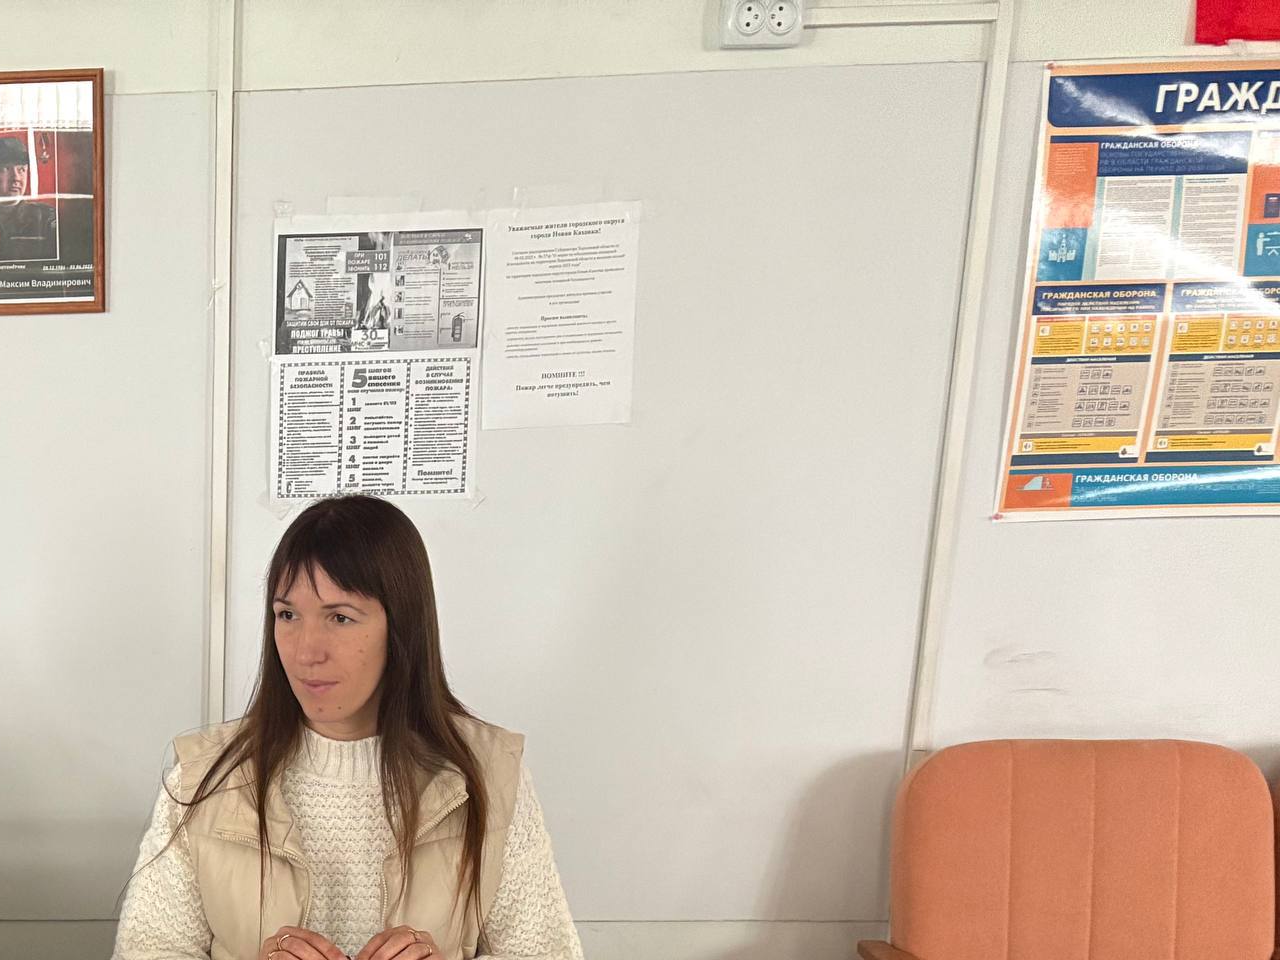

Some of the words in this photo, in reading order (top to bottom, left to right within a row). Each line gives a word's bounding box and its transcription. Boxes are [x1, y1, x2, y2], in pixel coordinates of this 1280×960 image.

[1155, 80, 1280, 115] ГРАЖД
[1100, 141, 1159, 150] ГРАЖДАНСКАЯ
[374, 252, 387, 260] 101
[374, 263, 388, 271] 112
[0, 280, 30, 288] Максим
[31, 279, 92, 288] Владимирович
[1042, 291, 1111, 300] ГРАЖДАНСКАЯ
[1112, 290, 1157, 298] ОБОРОНА
[290, 329, 319, 339] ПОДЖОГ
[320, 328, 344, 338] ТРАВЫ
[361, 329, 377, 340] 30
[292, 344, 341, 354] ПРЕСТУПЛЕНИЕ
[351, 368, 368, 388] 5
[541, 371, 577, 379] ПОМНИТЕ
[351, 397, 356, 406] 1
[349, 416, 357, 425] 2
[349, 436, 356, 444] 3
[348, 455, 356, 463] 4
[348, 474, 356, 482] 5
[1075, 473, 1149, 483] ГРАЖДАНСКАЯ
[1151, 473, 1199, 482] ОБОРОНА
